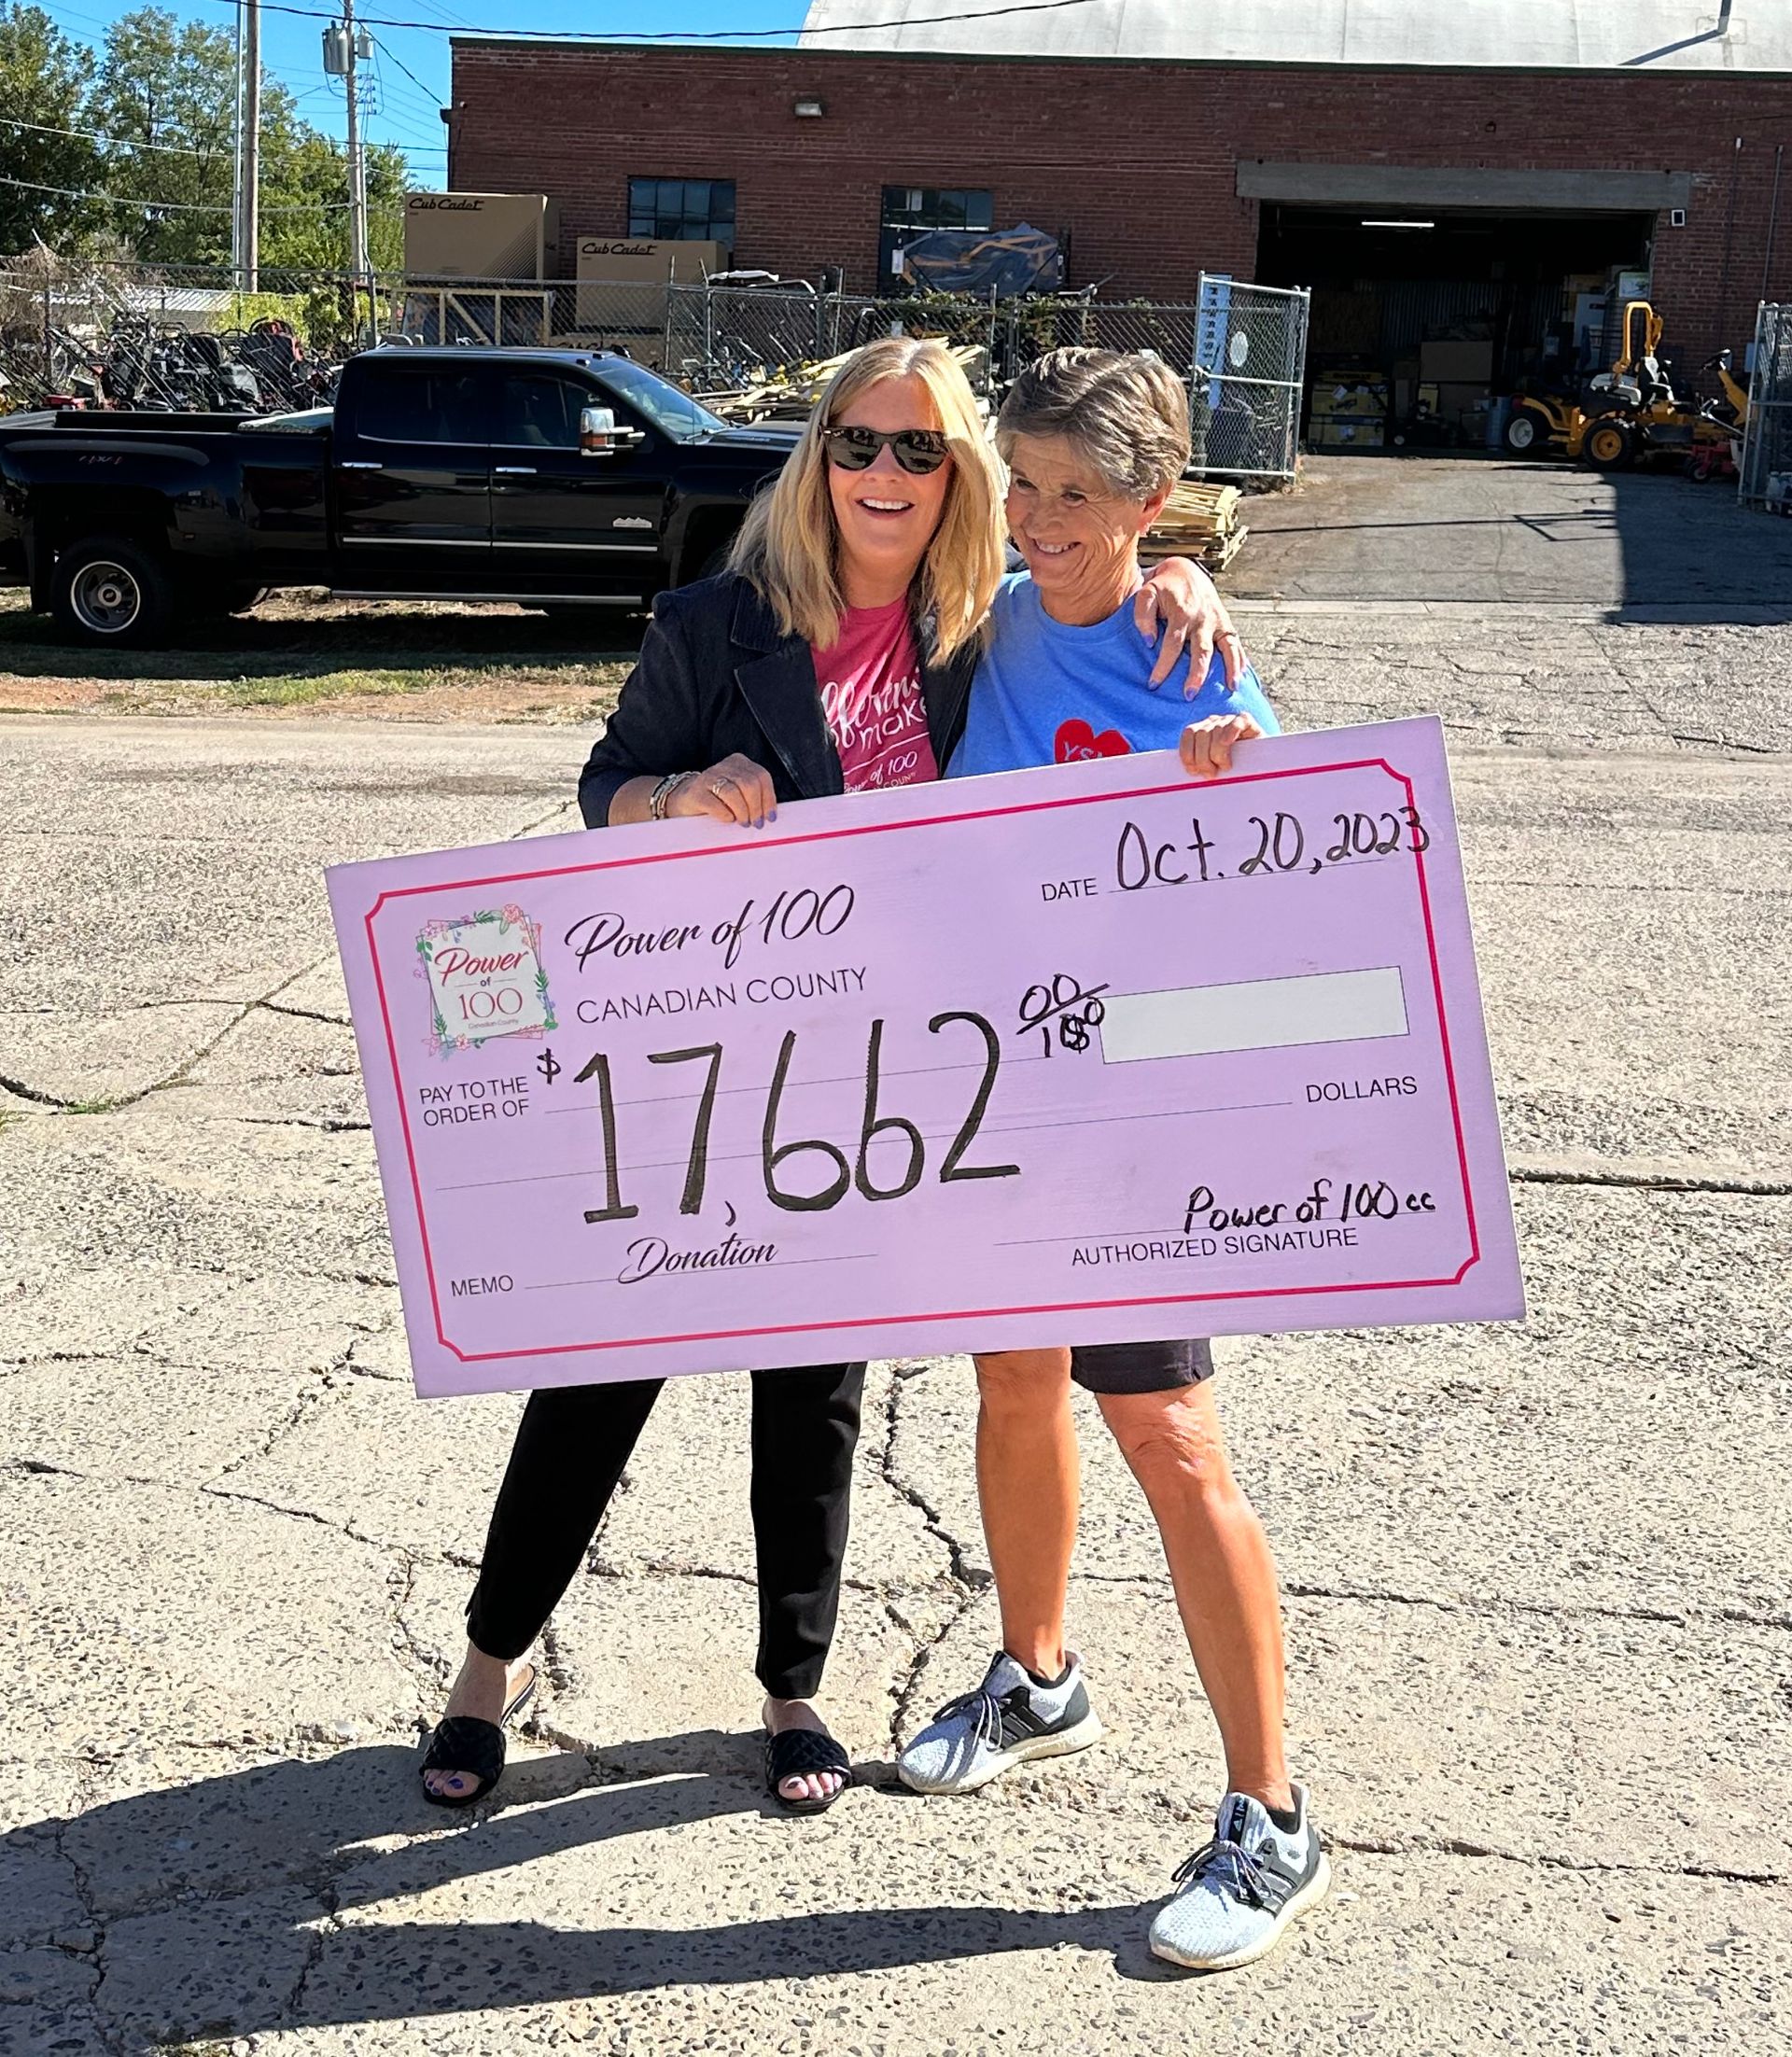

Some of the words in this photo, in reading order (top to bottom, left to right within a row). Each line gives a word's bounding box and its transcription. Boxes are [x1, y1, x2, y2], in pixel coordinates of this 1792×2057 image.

[409, 197, 436, 210] Cub
[438, 198, 484, 211] Cadet
[582, 243, 609, 254] Cub
[611, 243, 657, 256] Cadet
[870, 763, 884, 785] of
[888, 751, 917, 776] 100
[1119, 818, 1225, 890] Oct.
[1042, 877, 1099, 902] DATE
[565, 912, 702, 973] Power
[711, 900, 754, 970] of
[759, 885, 854, 945] 100
[434, 947, 529, 987] Power
[480, 976, 491, 987] of
[458, 987, 523, 1020] 100
[577, 983, 736, 1024] CANADIAN
[747, 967, 866, 1003] COUNTY
[419, 1084, 453, 1104] PAY
[457, 1082, 485, 1099] TO
[486, 1076, 529, 1097] THE
[1307, 1076, 1418, 1103] DOLLARS
[423, 1102, 497, 1126] ORDER
[502, 1098, 529, 1117] OF
[1183, 1185, 1287, 1234] Power
[1295, 1179, 1332, 1224] of
[1339, 1181, 1398, 1223] 100
[1406, 1190, 1436, 1212] cc
[618, 1232, 777, 1284] Donation
[1071, 1237, 1217, 1266] AUTHORIZED
[1225, 1227, 1359, 1255] SIGNATURE
[451, 1275, 513, 1297] MEMO
